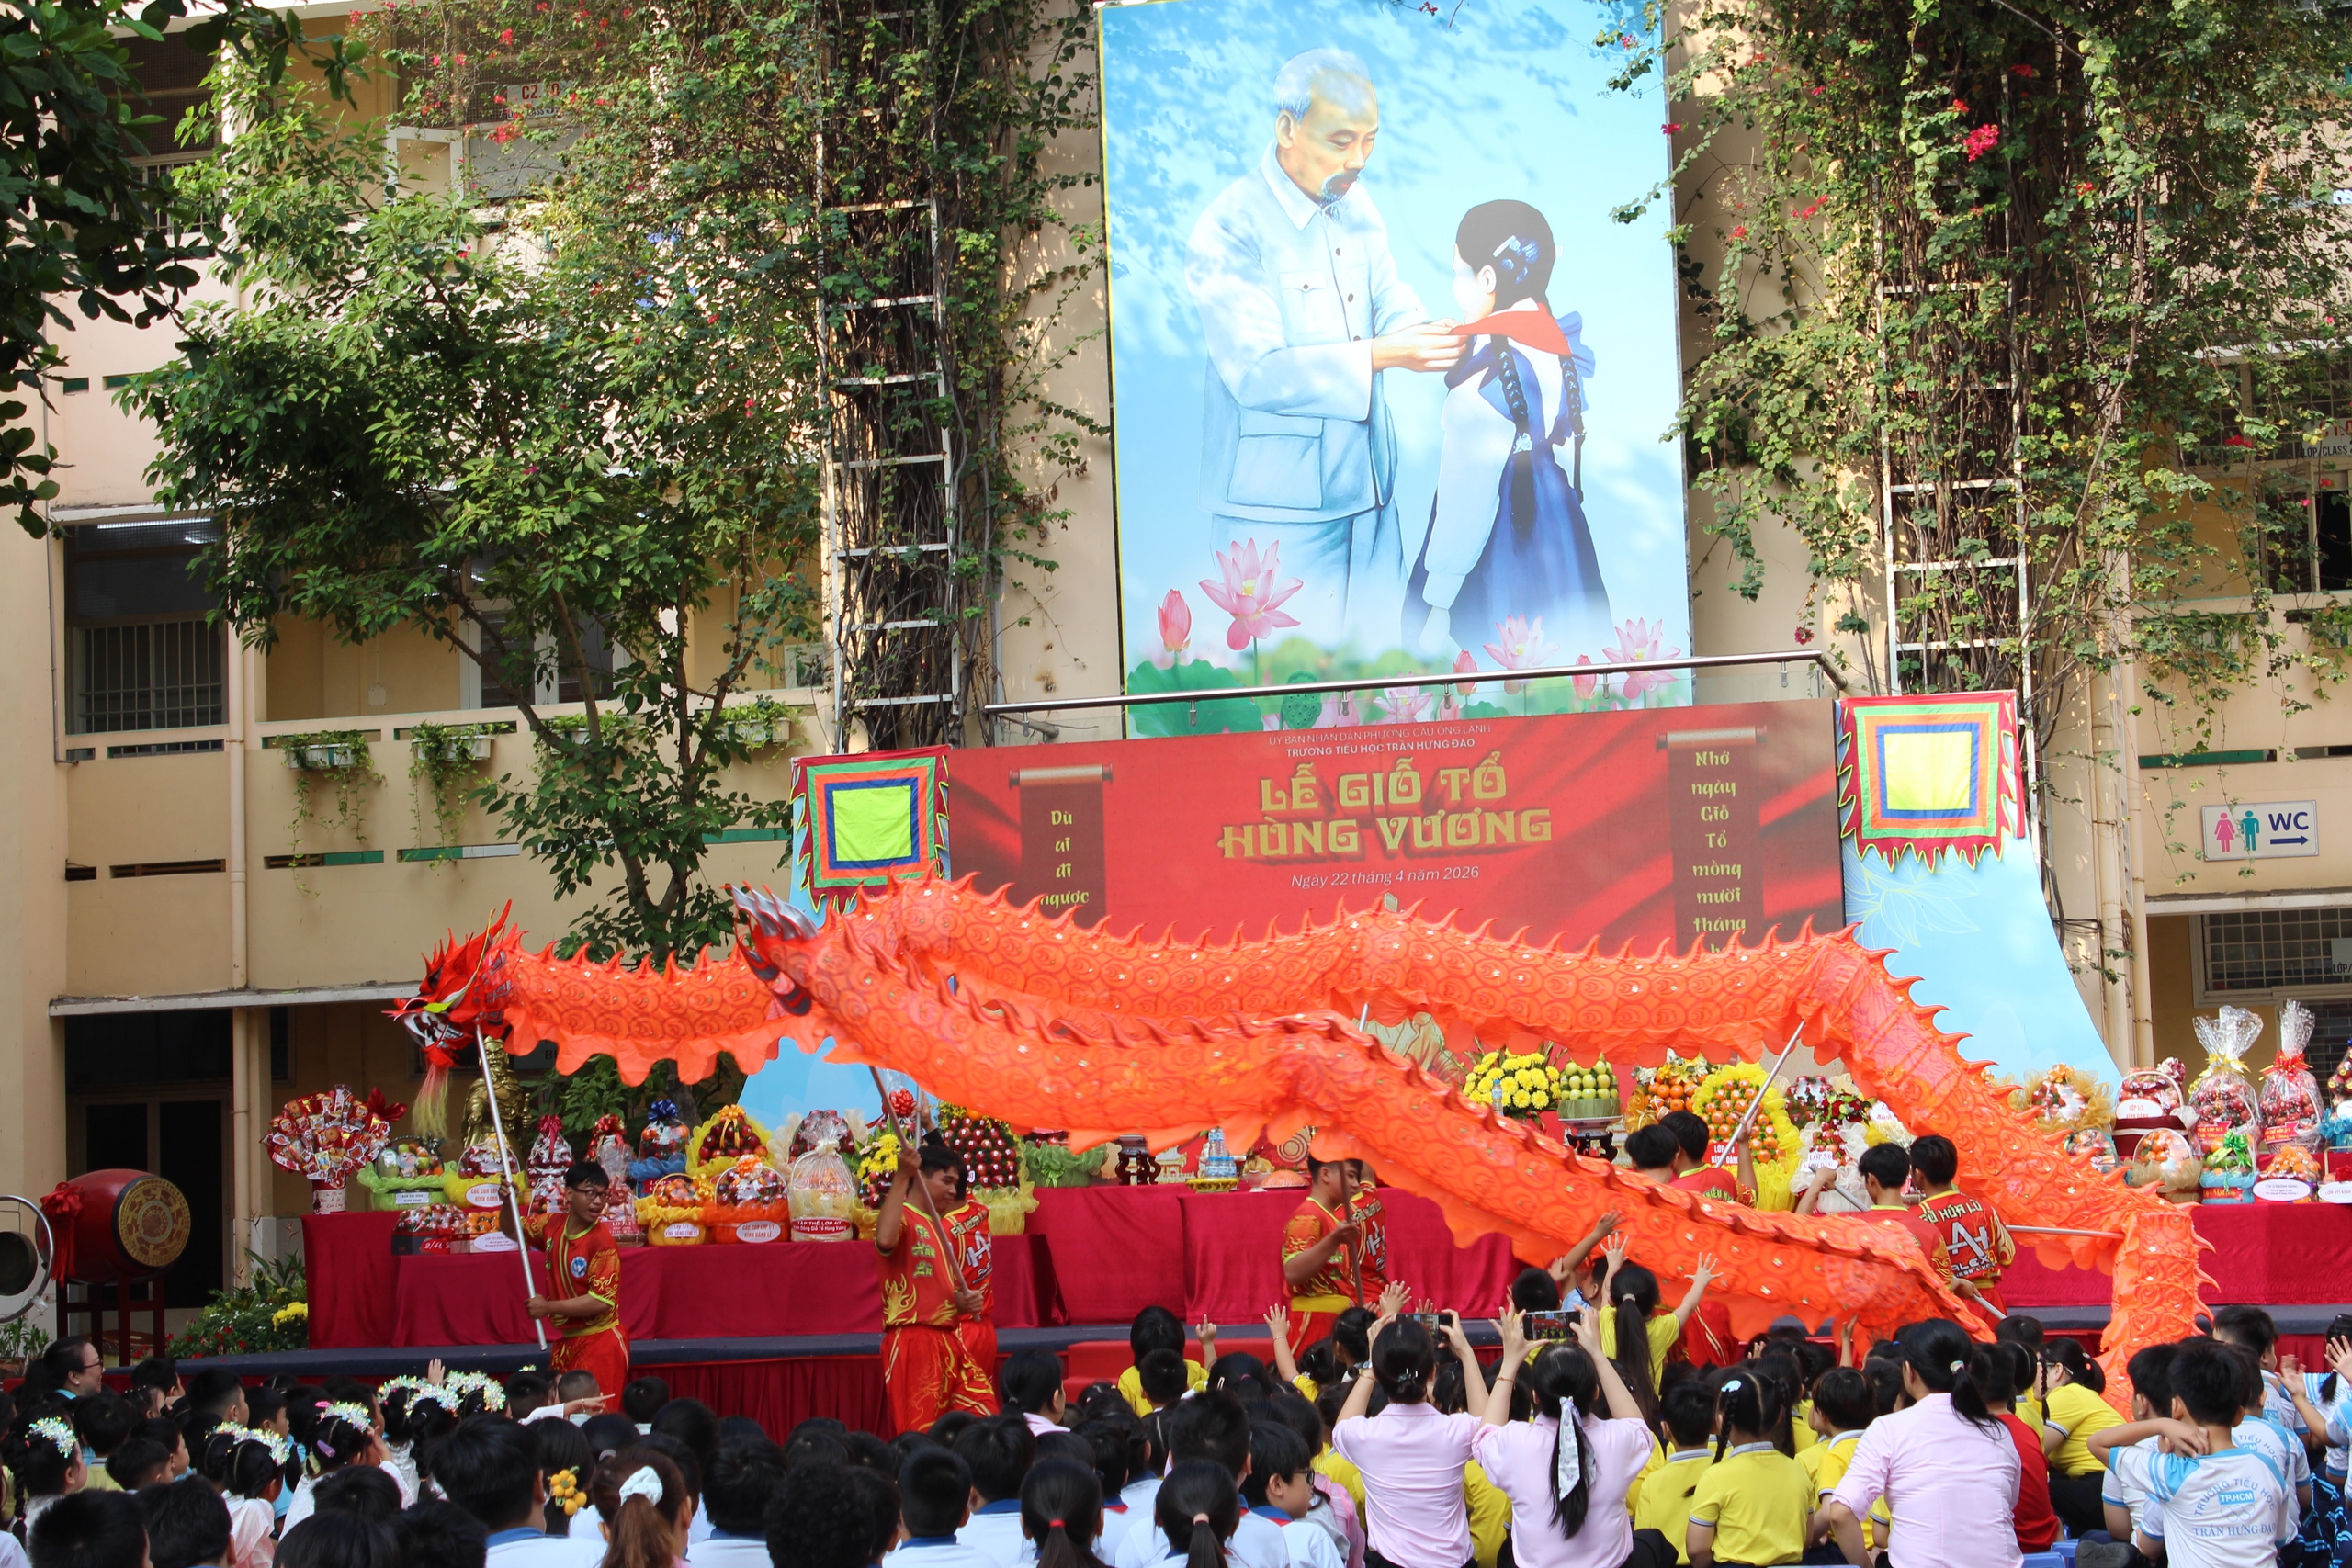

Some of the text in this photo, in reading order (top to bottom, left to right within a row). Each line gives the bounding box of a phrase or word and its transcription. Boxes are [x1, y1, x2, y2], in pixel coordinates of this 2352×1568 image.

[1284, 735, 1306, 745] BAN
[1307, 732, 1338, 743] NHÂN
[1340, 730, 1362, 741] DÂN
[1437, 725, 1461, 736] ÔNG
[1286, 738, 1476, 758] TRƯỜNG TIỂU HỌC TRẦN HƯNG ĐẠO
[1695, 750, 1730, 767] Nhớ
[1261, 750, 1507, 812] LỄ GIỖ TỔ
[1691, 779, 1736, 799] ngày
[1051, 810, 1073, 826] Dù
[1701, 804, 1730, 822] Giỗ
[2267, 811, 2309, 831] WC
[1216, 807, 1553, 859] HÙNG VƯƠNG
[1705, 829, 1727, 849] Tổ
[1055, 837, 1071, 852] ai
[1056, 863, 1072, 878] đi
[1291, 865, 1480, 890] Ngày 22 tháng 4 năm 2026
[1692, 859, 1742, 880] mồng
[1040, 890, 1090, 909] ngược
[1696, 887, 1742, 904] mười
[1693, 917, 1746, 935] tháng
[2220, 1492, 2254, 1503] TP.HCM
[2228, 1524, 2259, 1537] HƯNG
